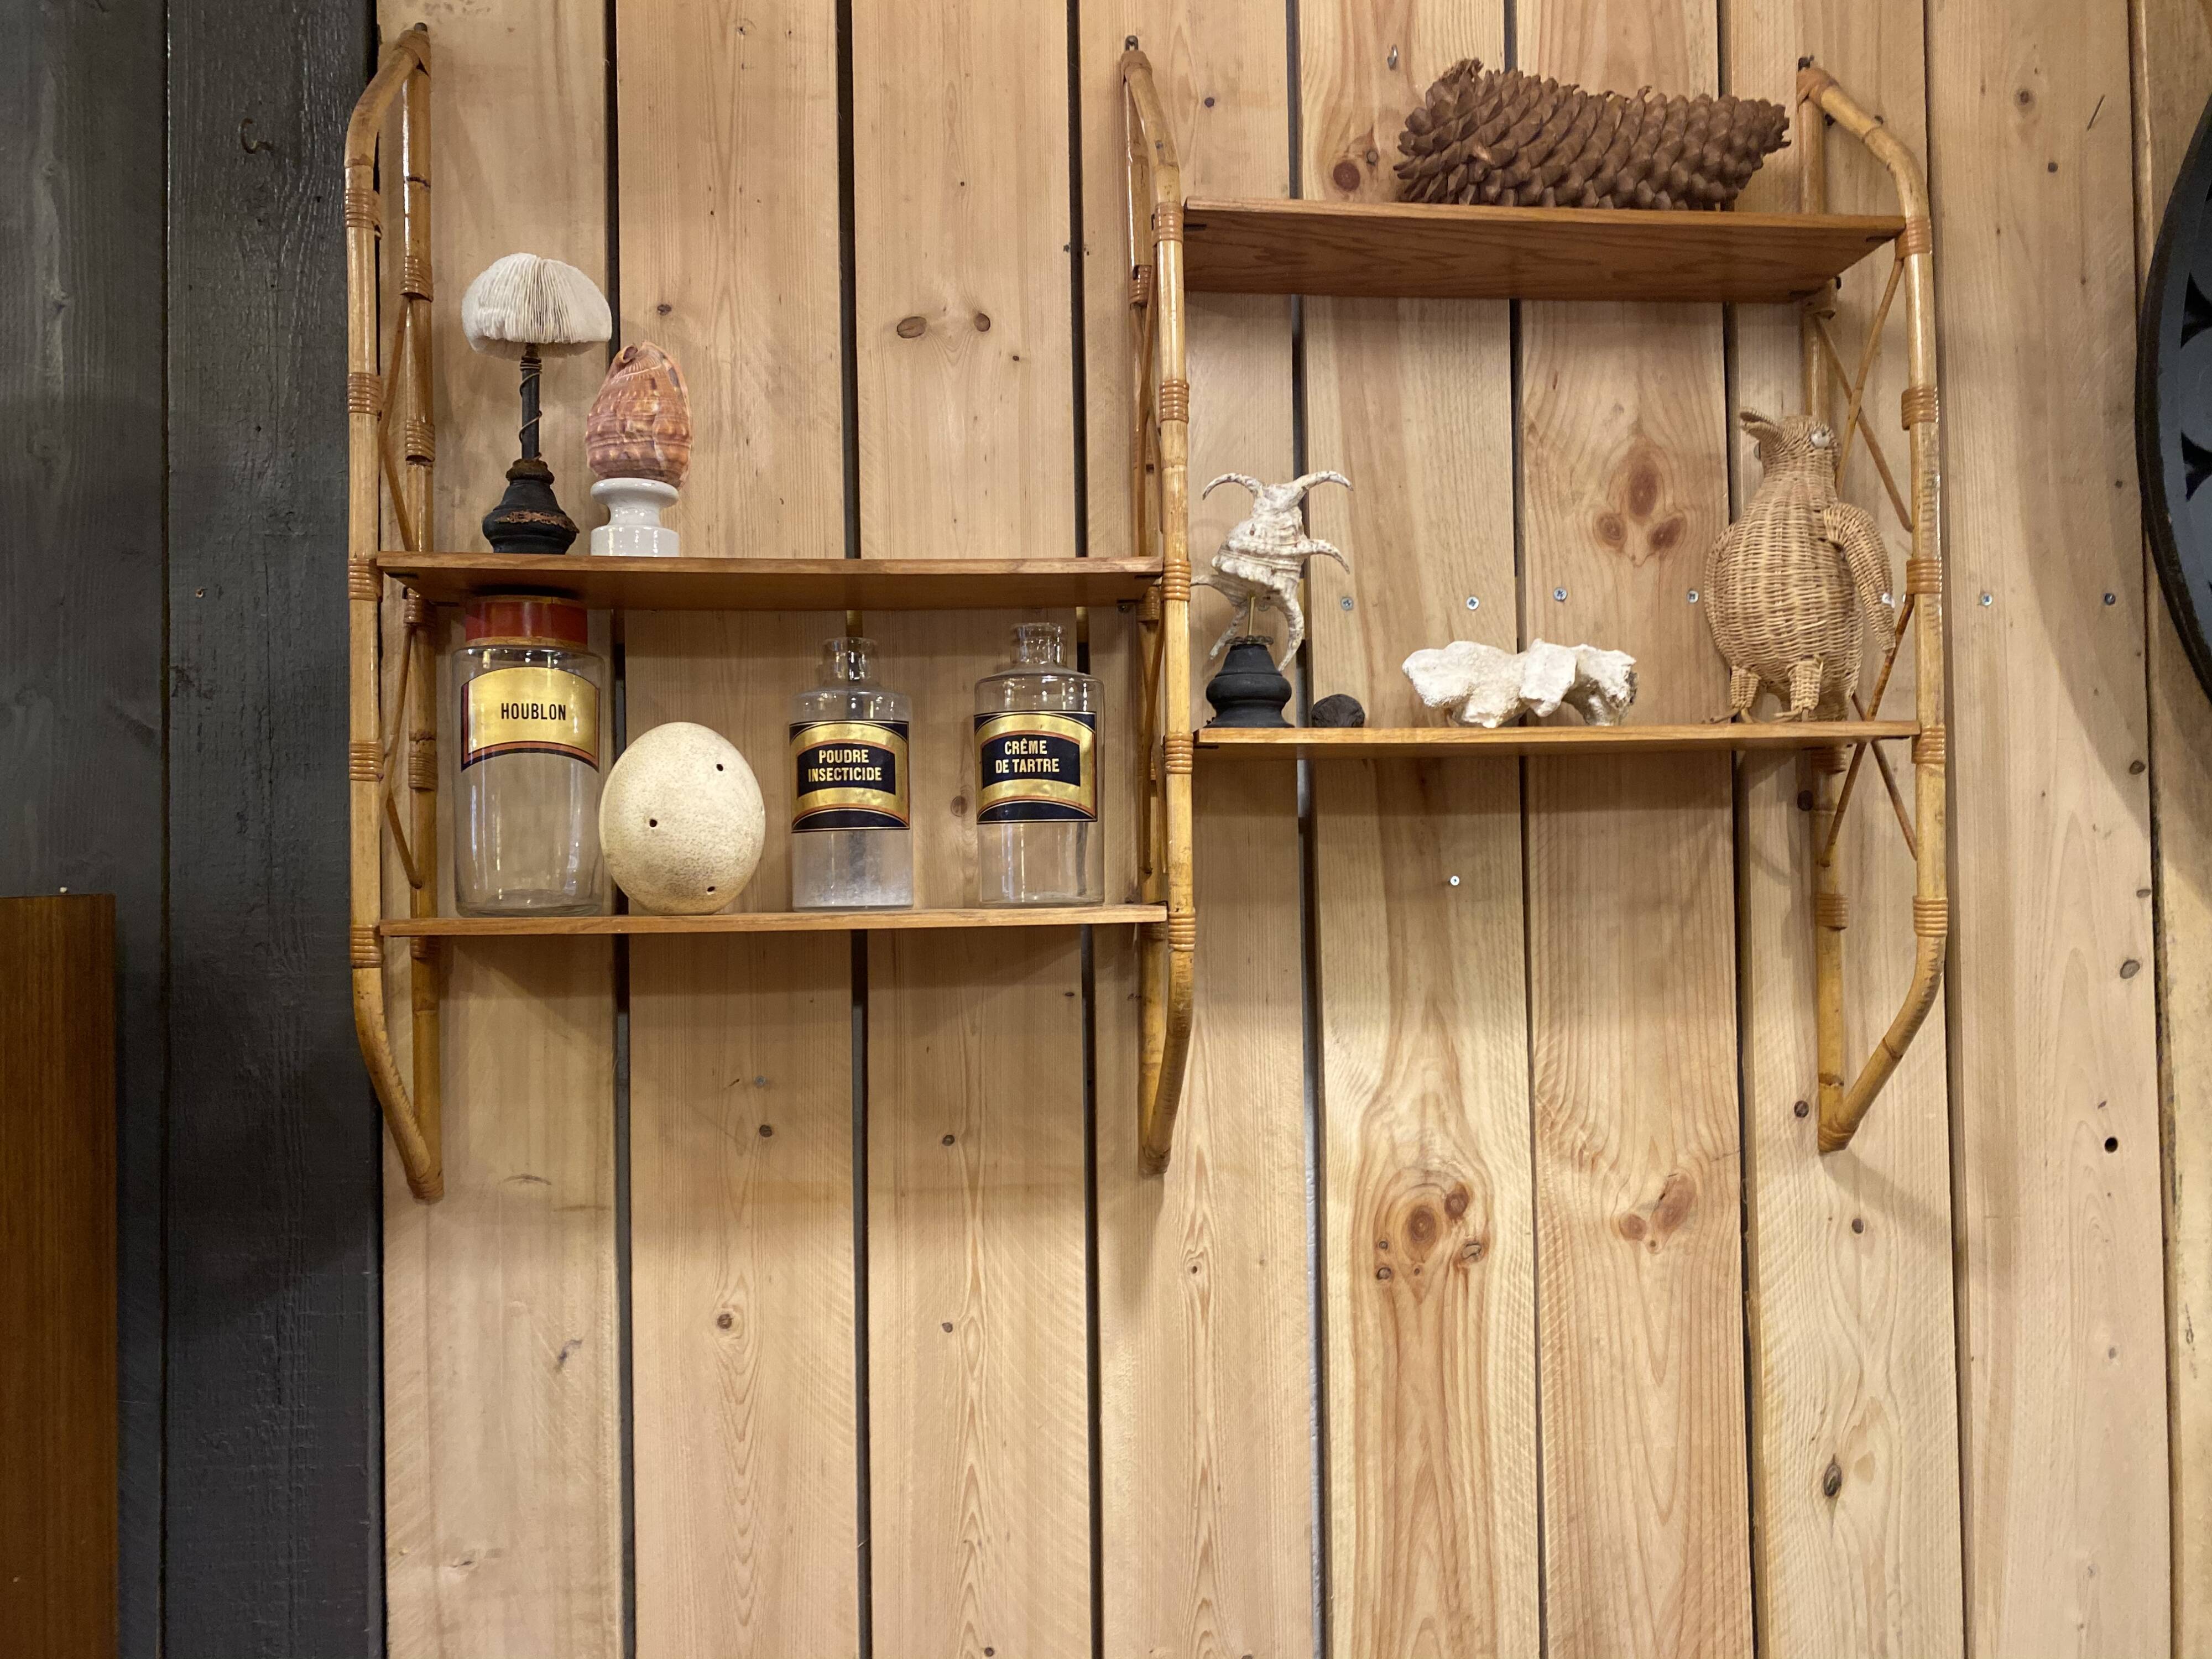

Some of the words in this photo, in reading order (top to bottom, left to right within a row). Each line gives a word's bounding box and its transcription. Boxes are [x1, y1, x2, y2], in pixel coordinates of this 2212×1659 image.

[500, 702, 567, 721] HOUBLON
[1004, 738, 1047, 755] CRÊME
[818, 749, 869, 764] POUDRE
[807, 766, 882, 782] INSECTICIDE
[995, 758, 1010, 774] DE
[1011, 758, 1060, 773] TARTRE
